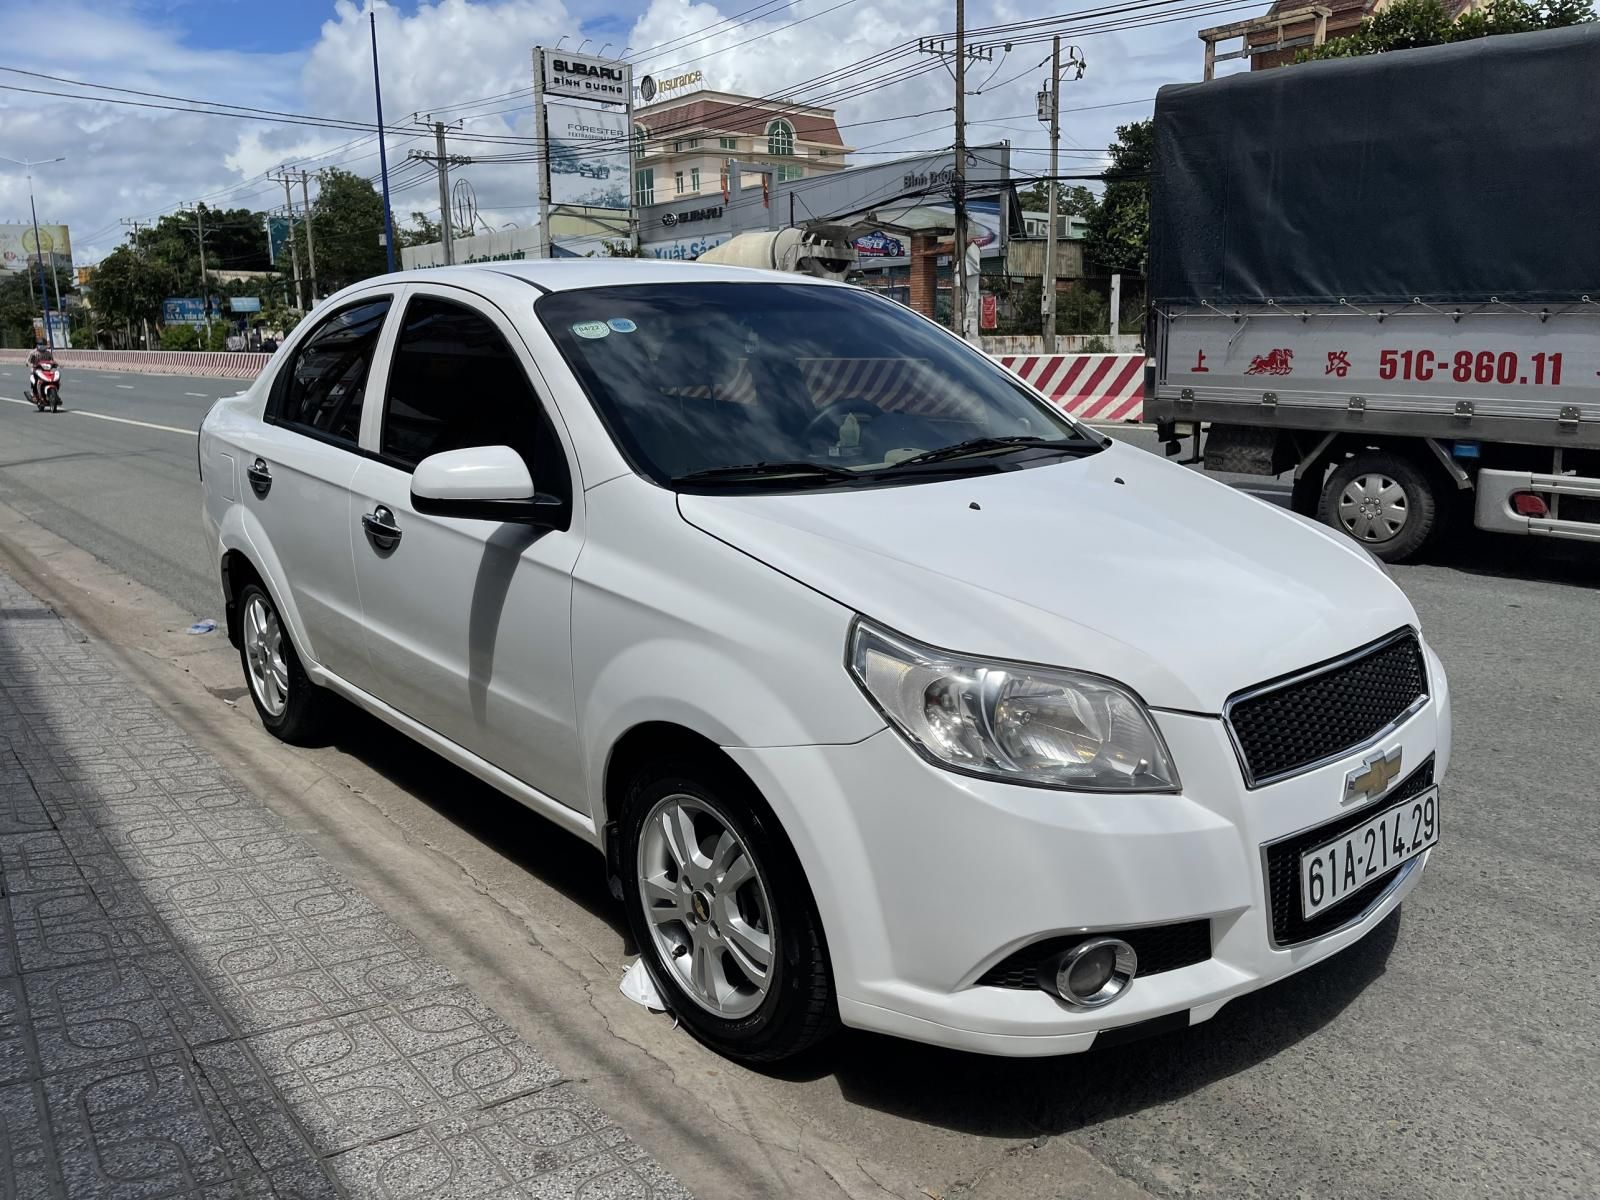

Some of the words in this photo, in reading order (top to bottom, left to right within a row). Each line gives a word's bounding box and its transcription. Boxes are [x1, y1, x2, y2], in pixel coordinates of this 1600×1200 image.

[553, 59, 622, 81] SUBARU
[553, 76, 580, 87] BÌNH
[658, 70, 702, 94] Insurance
[567, 123, 624, 137] FORESTER
[678, 206, 722, 223] SUBARU
[1191, 349, 1209, 373] 上
[1325, 351, 1352, 377] 路
[1379, 349, 1563, 386] 51C-860.11
[1308, 796, 1435, 907] 61A-214.29
